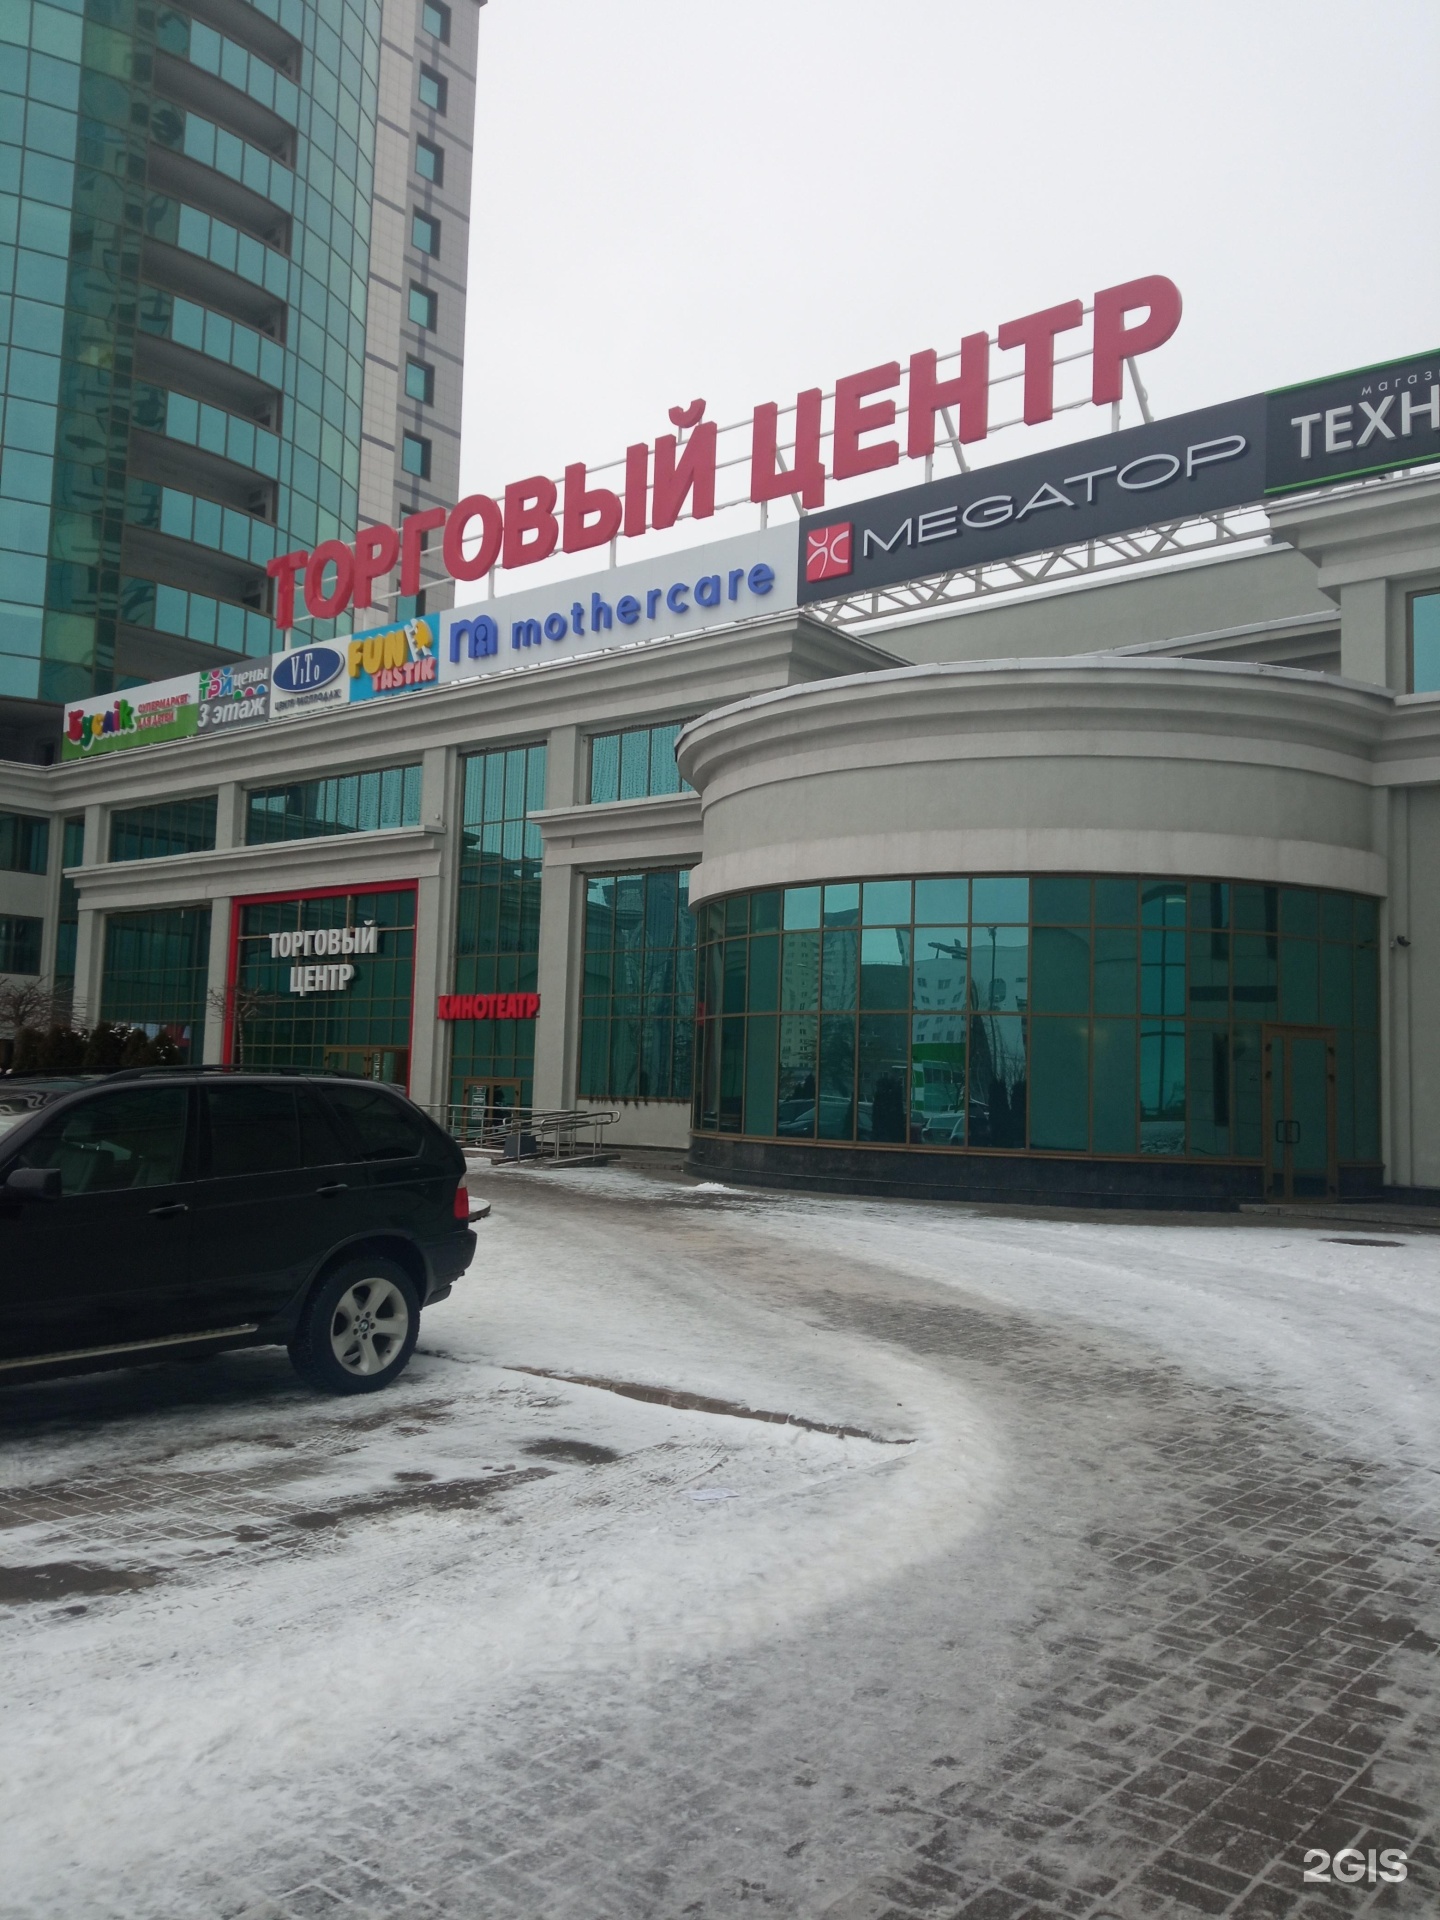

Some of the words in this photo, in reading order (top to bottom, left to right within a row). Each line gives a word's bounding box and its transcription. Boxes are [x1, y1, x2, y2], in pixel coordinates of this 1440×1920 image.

[1361, 369, 1440, 396] магаз
[266, 397, 717, 630] ТОРГОВЫЙ
[751, 274, 1184, 509] ЦЕНТР
[862, 434, 1248, 557] MEGATOP
[511, 563, 776, 650] mothercare
[348, 630, 408, 678] FUN
[232, 667, 270, 688] цены
[370, 656, 437, 692] TASTIK
[137, 692, 190, 715] СУПЕРМАРКЕТ
[137, 715, 152, 730] ДЛЯ
[152, 709, 177, 728] ДЕТЕЙ
[197, 704, 210, 728] 3
[211, 697, 267, 725] этаж
[269, 919, 378, 958] ТОРГОВЫЙ
[289, 963, 355, 997] ЦЕНТР
[437, 993, 540, 1020] КИНОТЕАТР
